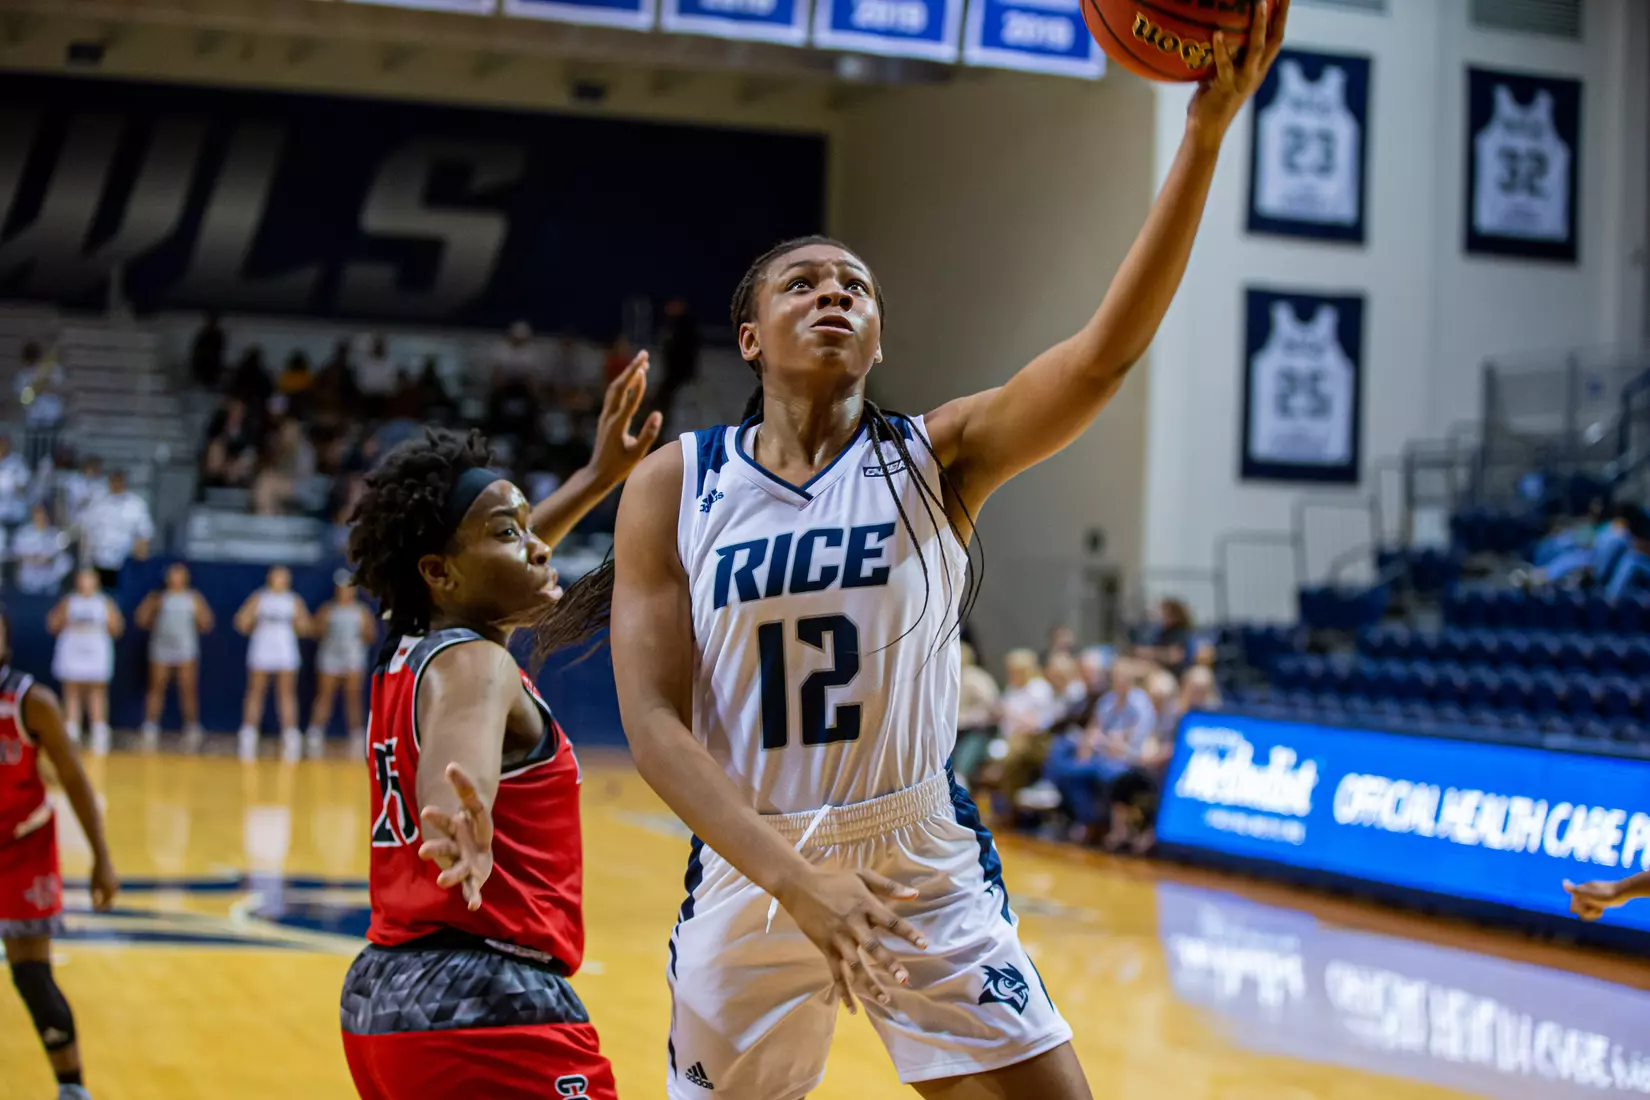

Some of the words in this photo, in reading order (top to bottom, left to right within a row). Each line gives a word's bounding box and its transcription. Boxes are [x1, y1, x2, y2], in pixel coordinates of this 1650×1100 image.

[1494, 144, 1553, 200] 32
[713, 522, 896, 611] RICE
[757, 612, 863, 751] 12
[1437, 787, 1548, 853] HEALTH
[1543, 802, 1626, 866] CARE
[685, 1072, 714, 1090] adidas
